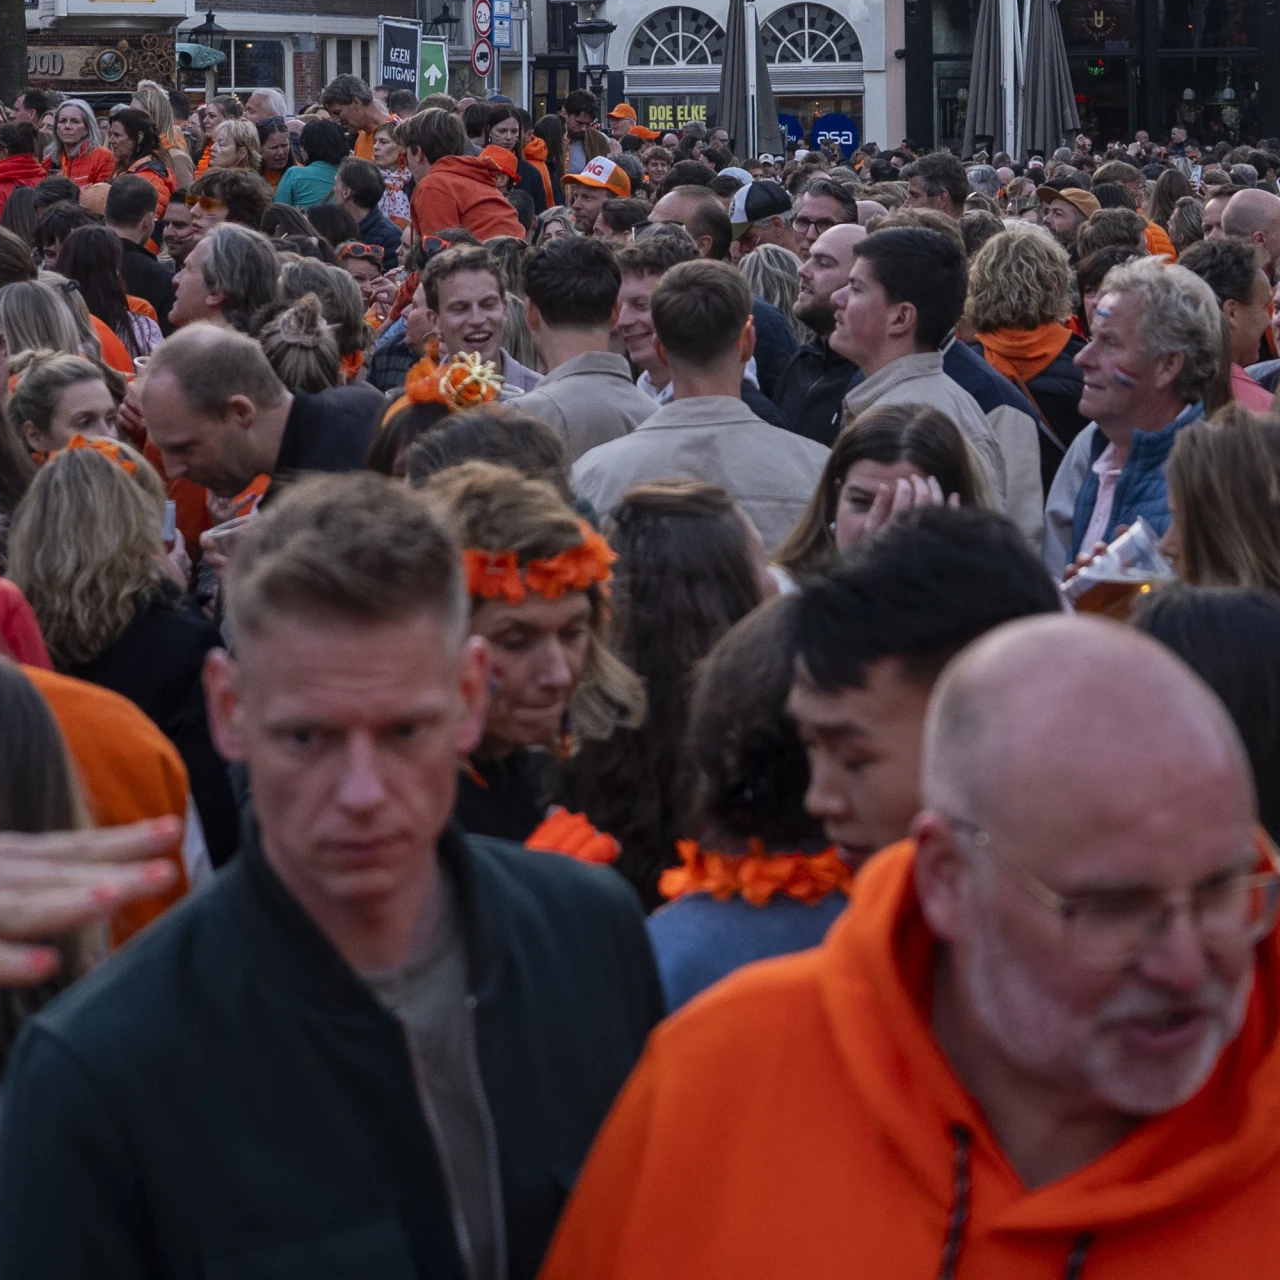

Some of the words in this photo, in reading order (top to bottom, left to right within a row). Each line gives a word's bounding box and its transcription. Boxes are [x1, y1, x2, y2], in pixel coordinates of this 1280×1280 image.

[27, 51, 63, 75] OOD
[384, 66, 416, 82] UITGANG
[649, 105, 673, 121] DOE
[677, 105, 707, 121] ELKE
[817, 131, 853, 145] asa
